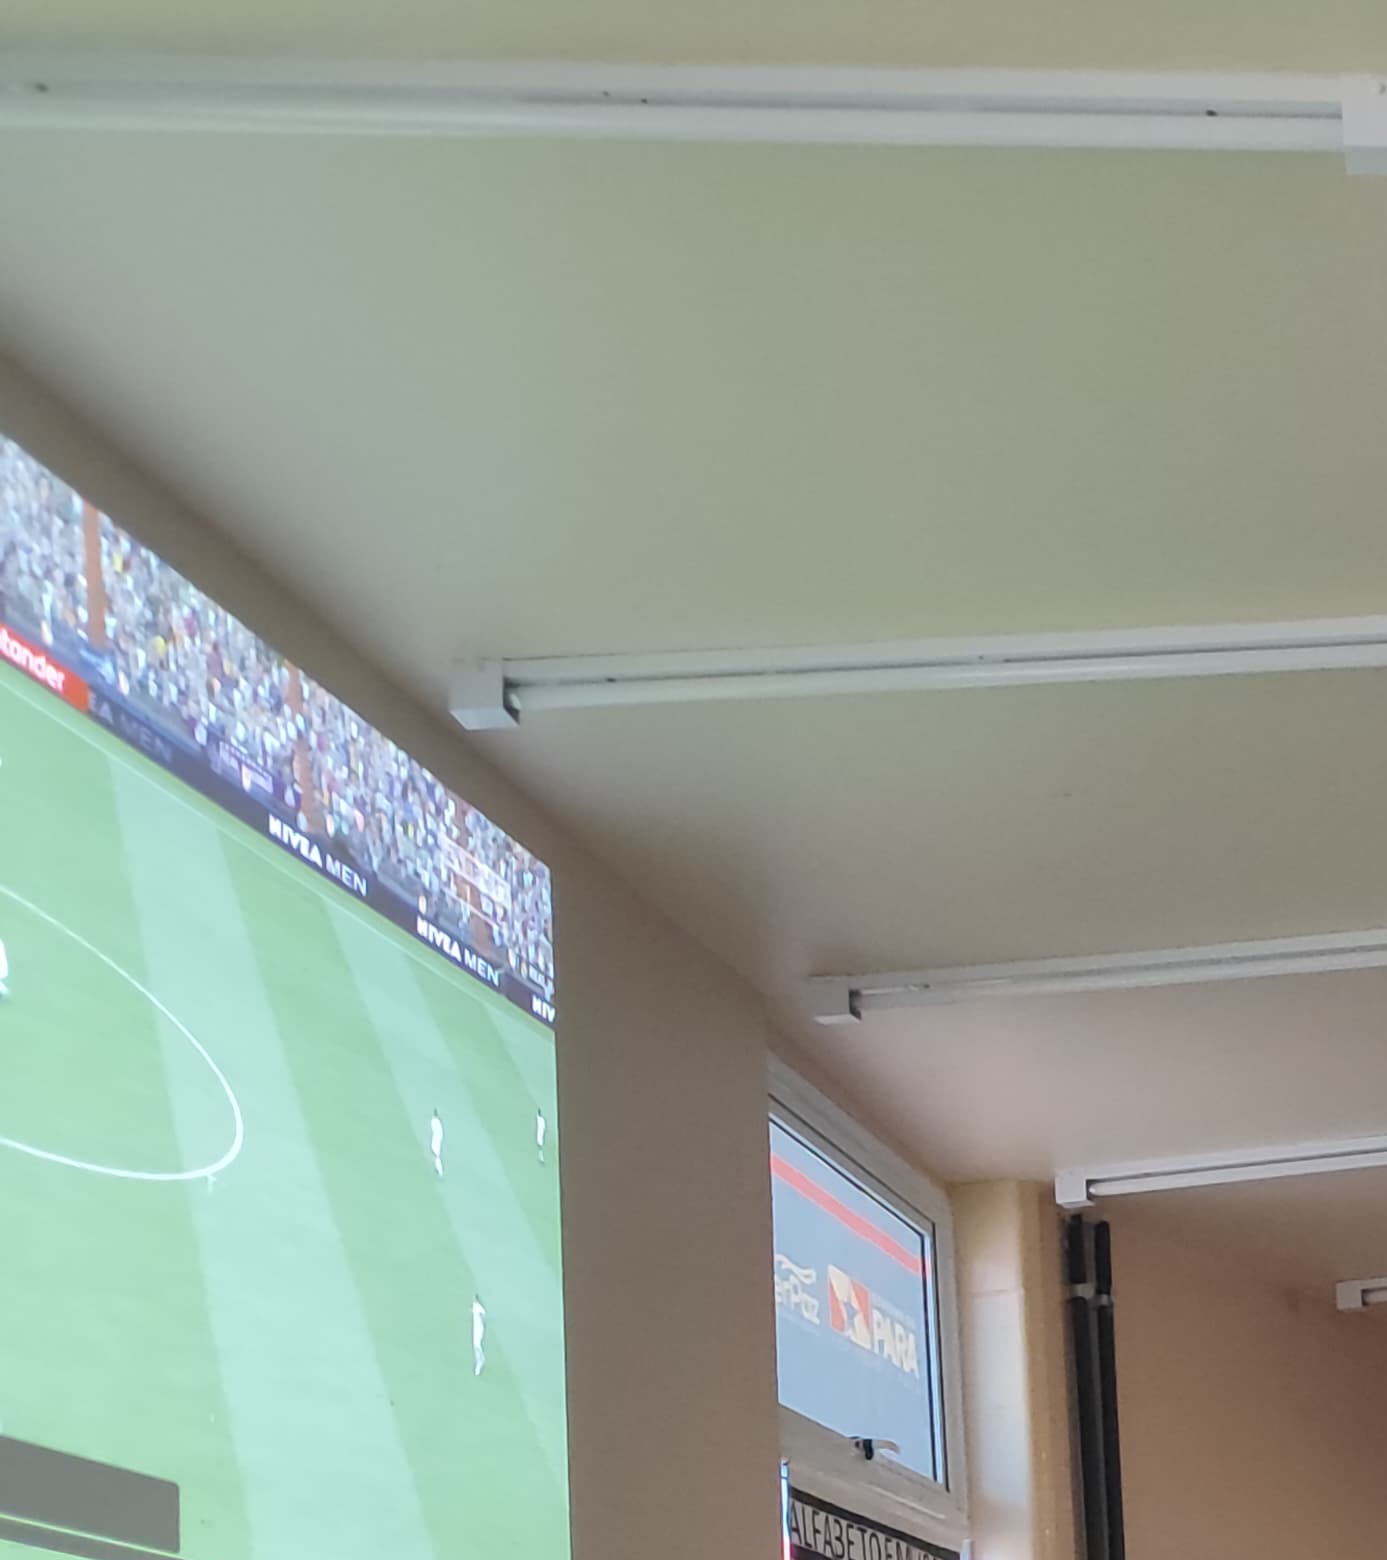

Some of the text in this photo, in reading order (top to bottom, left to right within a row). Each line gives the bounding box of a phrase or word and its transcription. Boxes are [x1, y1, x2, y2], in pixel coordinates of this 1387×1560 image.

[268, 812, 367, 897] NIVEA MEN
[416, 915, 463, 963] NIVEA
[463, 947, 500, 987] MEN
